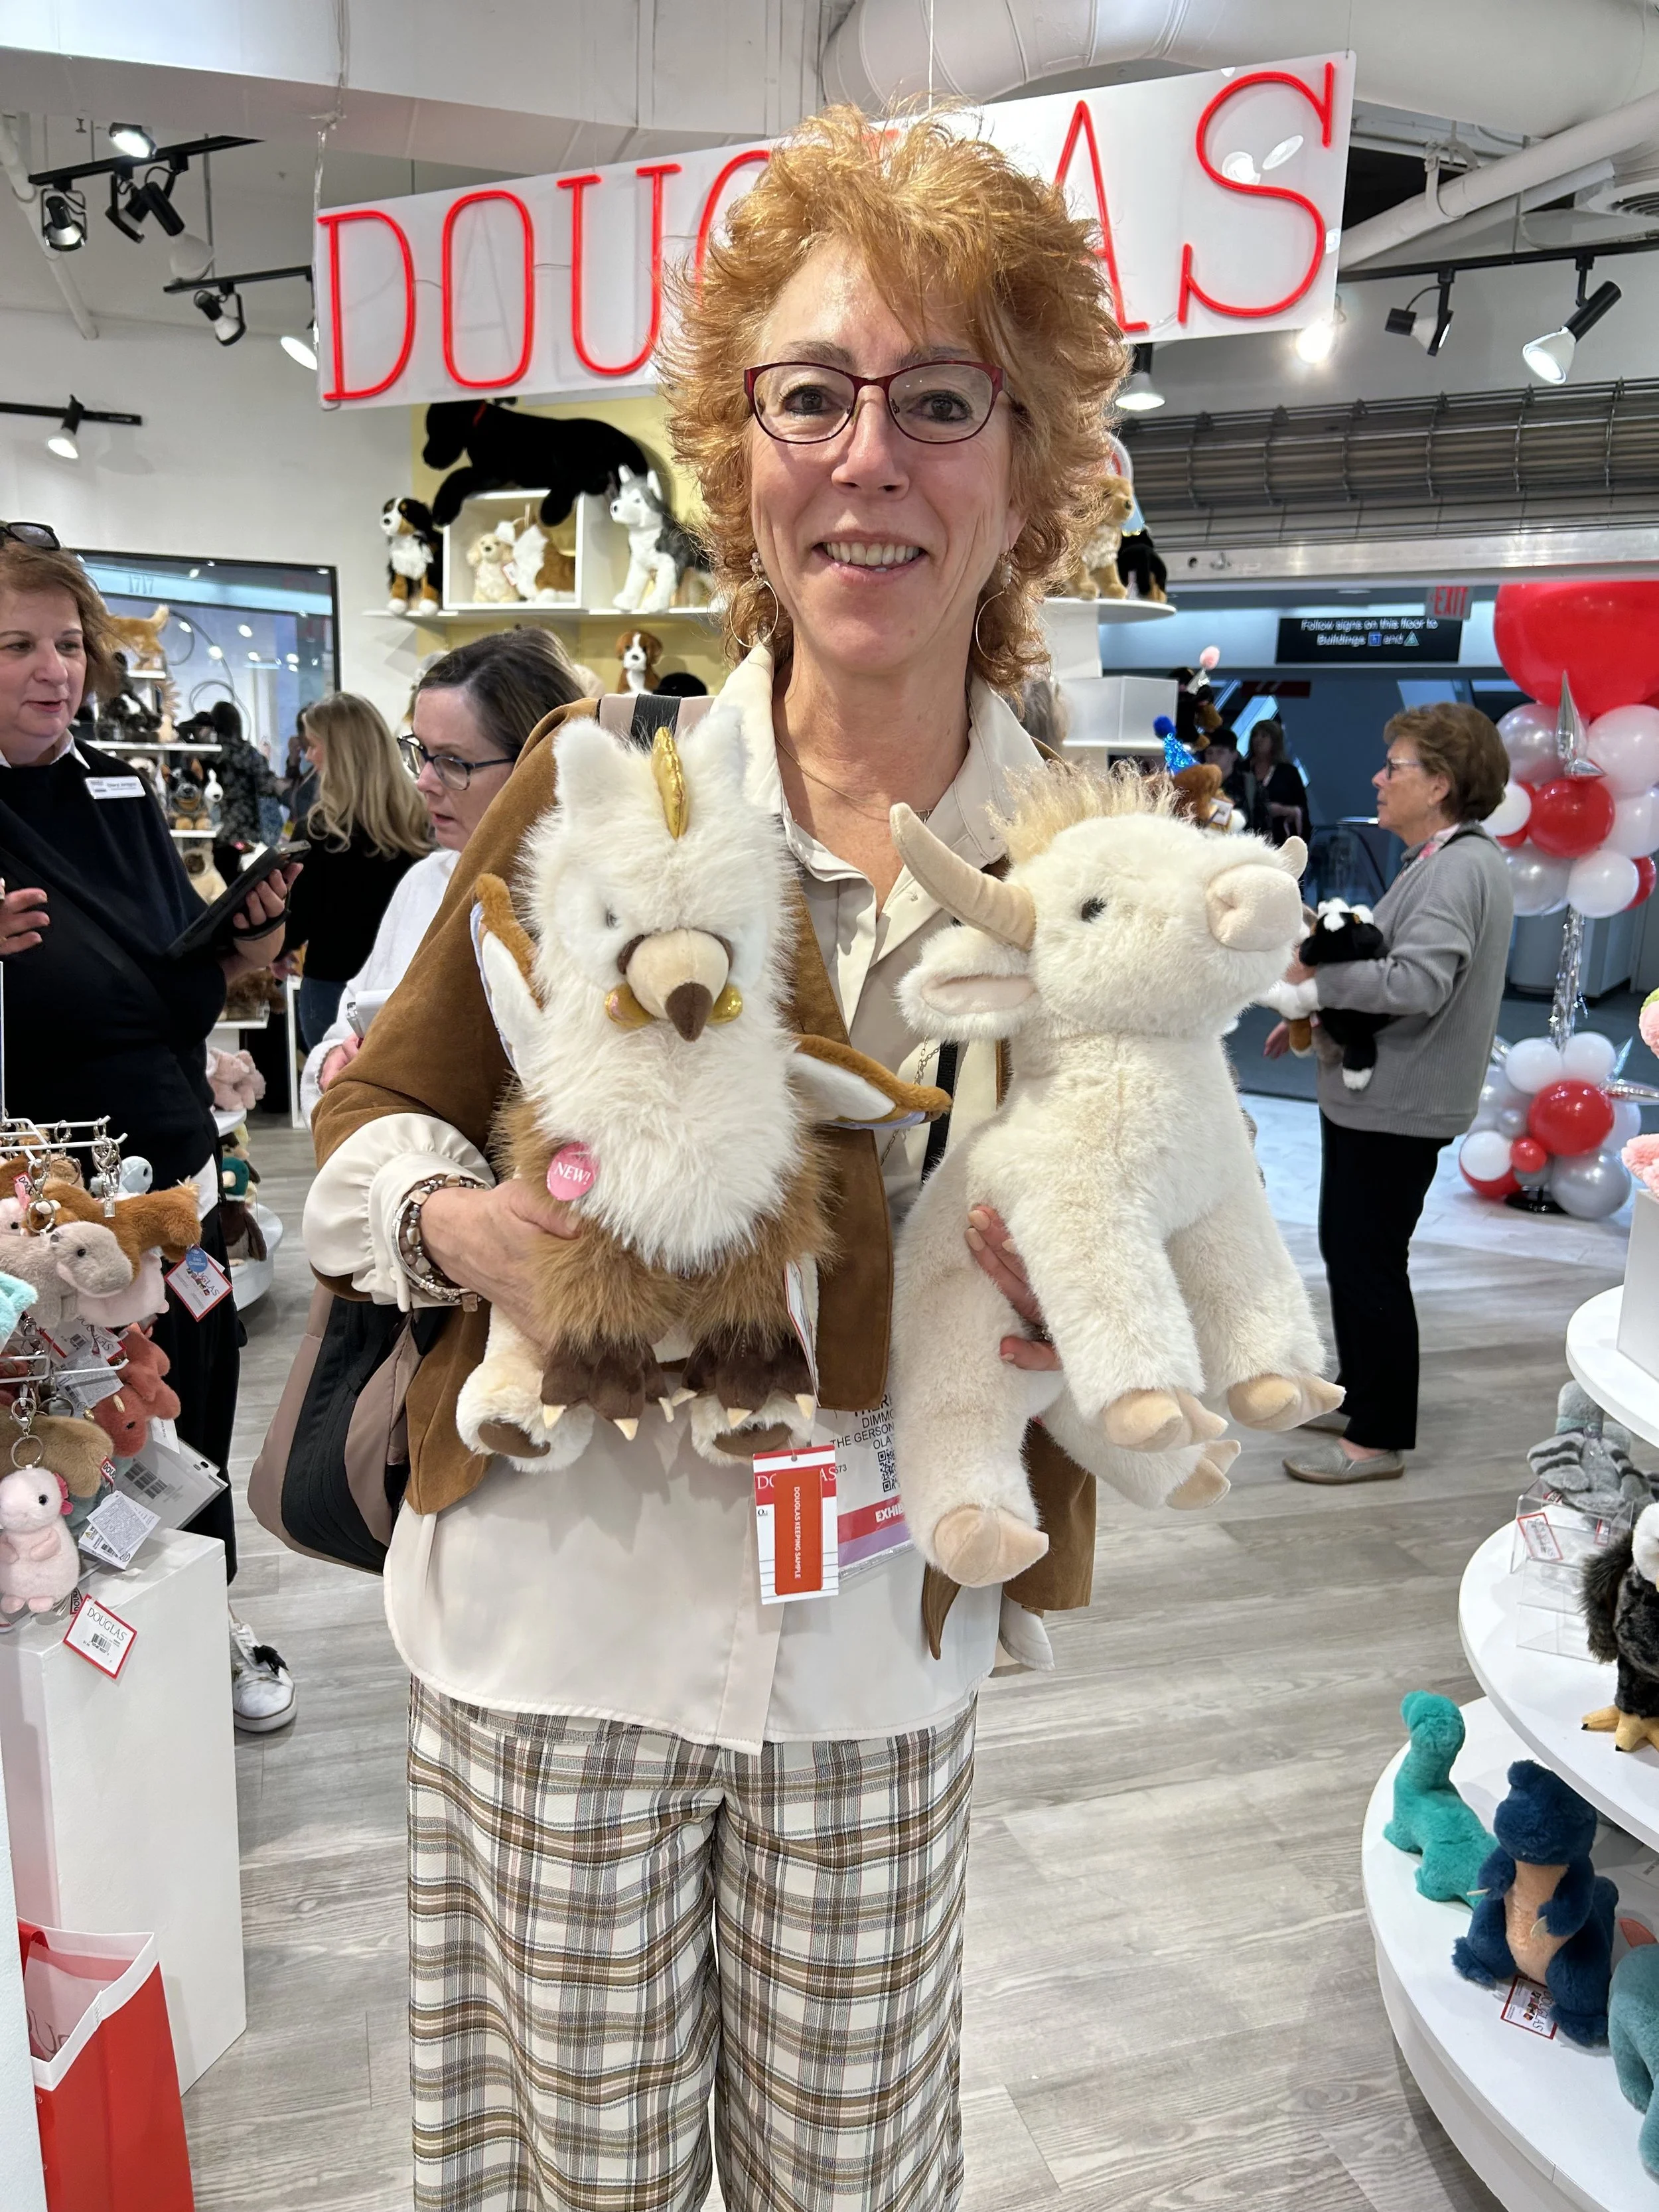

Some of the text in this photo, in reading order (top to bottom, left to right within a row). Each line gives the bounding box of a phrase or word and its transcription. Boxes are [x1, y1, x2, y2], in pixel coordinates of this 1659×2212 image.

[317, 62, 1334, 401] DOUAS
[1434, 585, 1469, 617] EXIT
[1301, 618, 1439, 632] Follow signs on this floor to
[1317, 633, 1366, 647] Buildings
[1383, 632, 1404, 645] and
[553, 1161, 591, 1185] NEW!
[853, 1422, 895, 1443] GERSON
[87, 1607, 127, 1641] DOUGLAS
